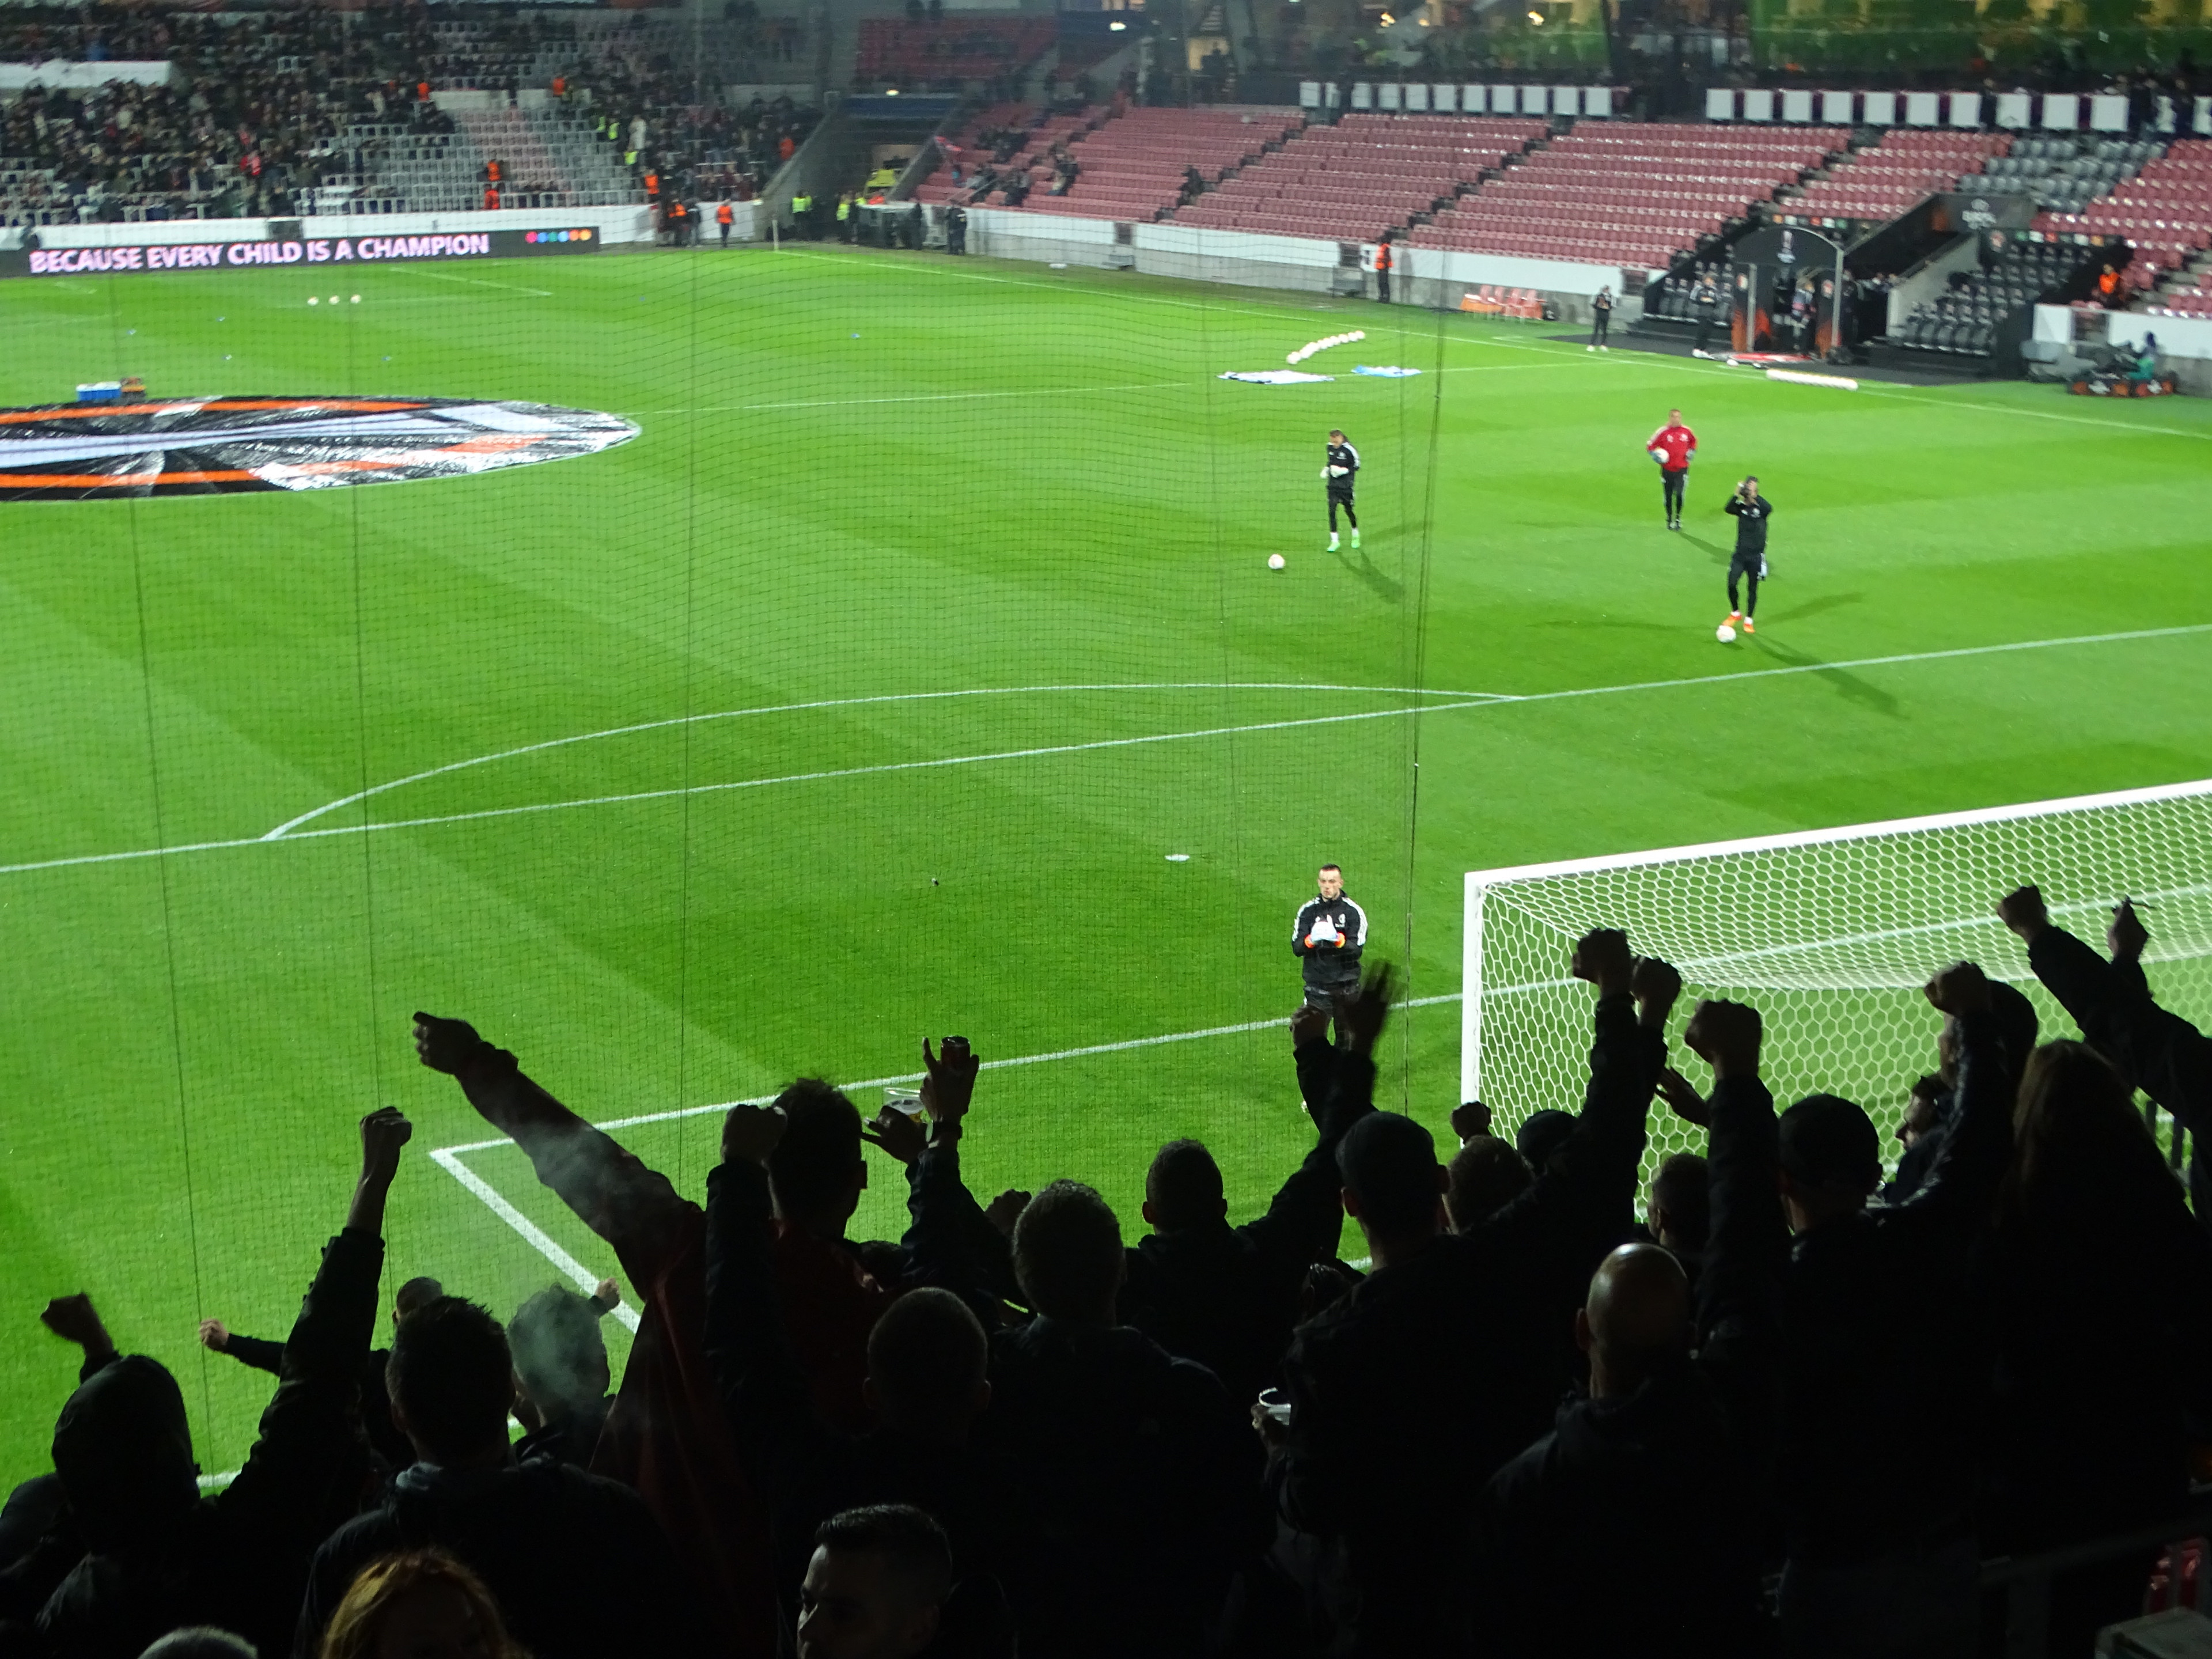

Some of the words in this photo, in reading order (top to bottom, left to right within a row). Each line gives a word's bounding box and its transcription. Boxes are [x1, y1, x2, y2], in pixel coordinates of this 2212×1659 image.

[29, 248, 143, 274] BECAUSE
[146, 244, 224, 269] EVERY
[227, 240, 302, 265] CHILD
[306, 239, 330, 262] IS
[335, 238, 354, 261] A
[358, 233, 489, 259] CHAMPION
